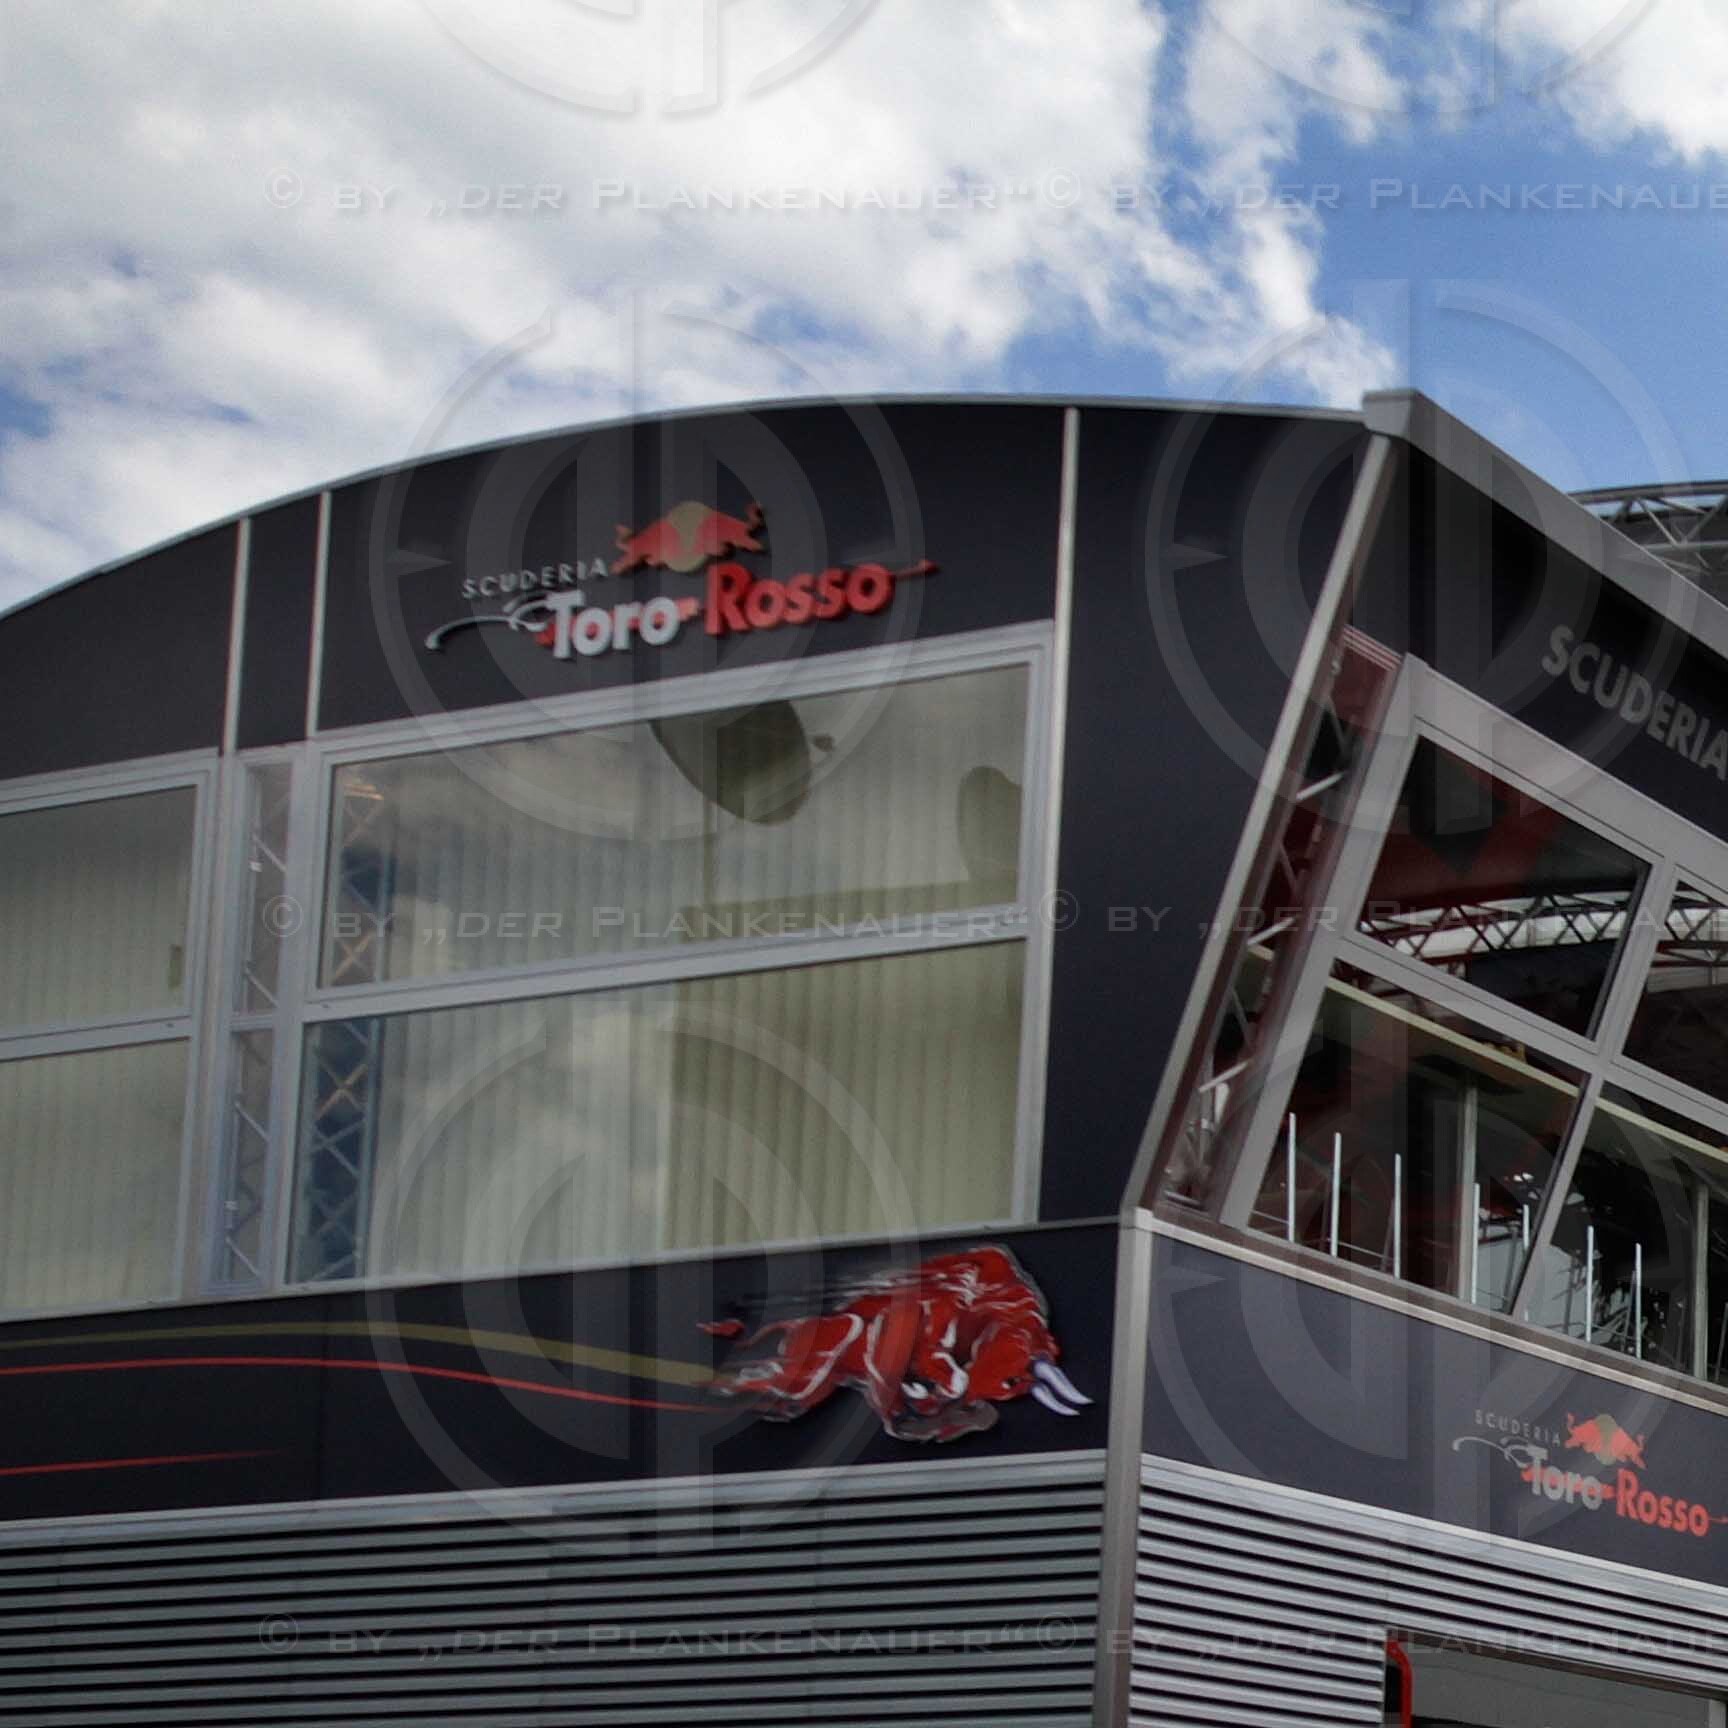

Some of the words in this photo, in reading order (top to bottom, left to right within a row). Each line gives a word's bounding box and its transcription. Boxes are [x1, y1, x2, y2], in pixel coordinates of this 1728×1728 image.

[460, 555, 612, 601] SCUDERIA
[546, 590, 681, 661] Toro
[704, 562, 895, 638] Rosso
[1474, 1409, 1562, 1447] SCUDERIA
[1522, 1443, 1604, 1511] Toro
[1614, 1468, 1711, 1538] Rosso
